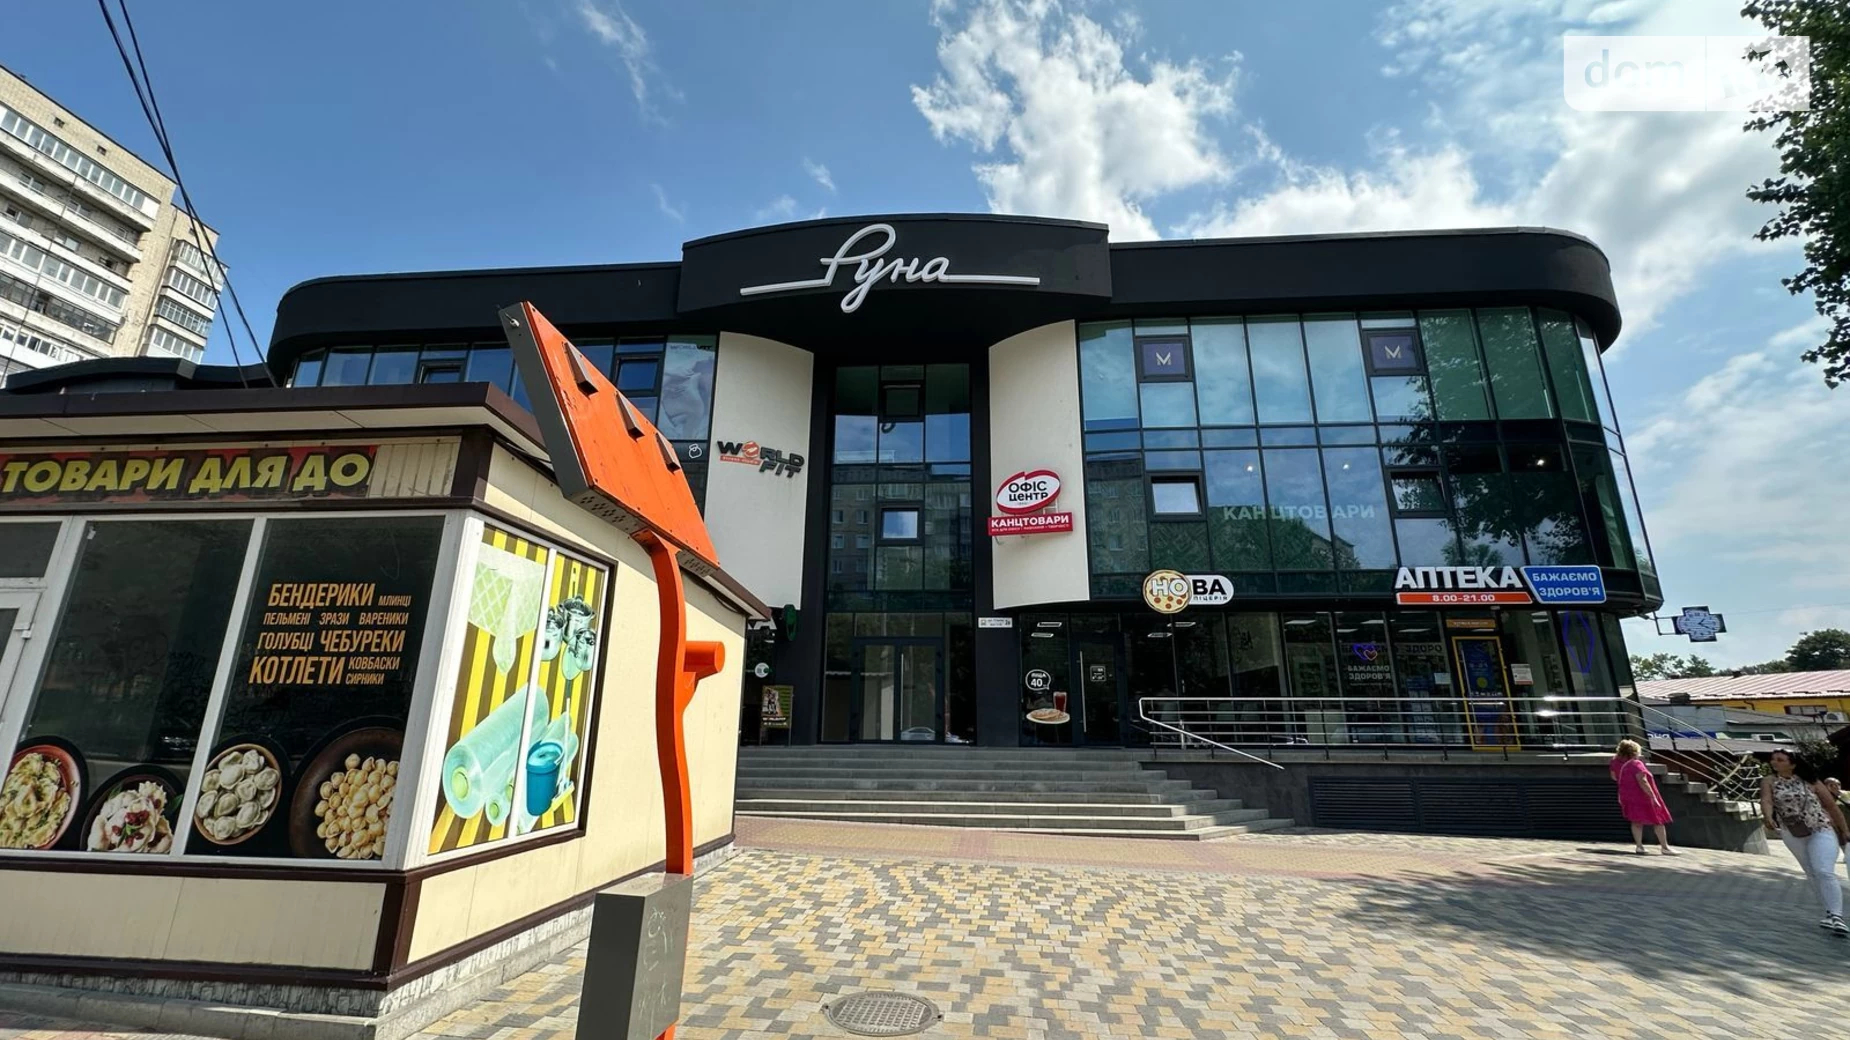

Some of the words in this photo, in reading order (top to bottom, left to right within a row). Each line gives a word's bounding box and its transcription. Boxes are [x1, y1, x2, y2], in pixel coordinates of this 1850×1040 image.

[717, 440, 804, 467] WORLD
[2, 457, 186, 494] ТОВАРИ
[189, 455, 290, 494] ДЛЯ
[759, 460, 802, 478] FIT
[1008, 481, 1047, 493] ОФІС
[991, 515, 1069, 528] КАНЦТОВАРИ
[1223, 505, 1375, 521] КАНЦТОВАРИ
[1395, 566, 1523, 589] АПТЕКА
[1532, 572, 1597, 582] БАЖАЄМО
[267, 583, 376, 609] БЕНДЕРИКИ
[378, 595, 412, 607] МЛИНЦІ
[1152, 578, 1227, 597] НОВА
[1539, 587, 1600, 598] ЗДОРОВ'Я
[263, 612, 311, 625] ПЕЛЬМЕНІ
[319, 612, 350, 625] ЗРАЗИ
[359, 612, 409, 625] ВАРЕНИКИ
[257, 632, 315, 651] ГОЛУБЦІ
[320, 630, 406, 652] ЧЕБУРЕКИ
[248, 656, 346, 685] КОТЛЕТИ
[348, 656, 400, 670] КОВБАСКИ
[345, 673, 385, 685] СИРНИКИ
[1031, 678, 1043, 687] 40
